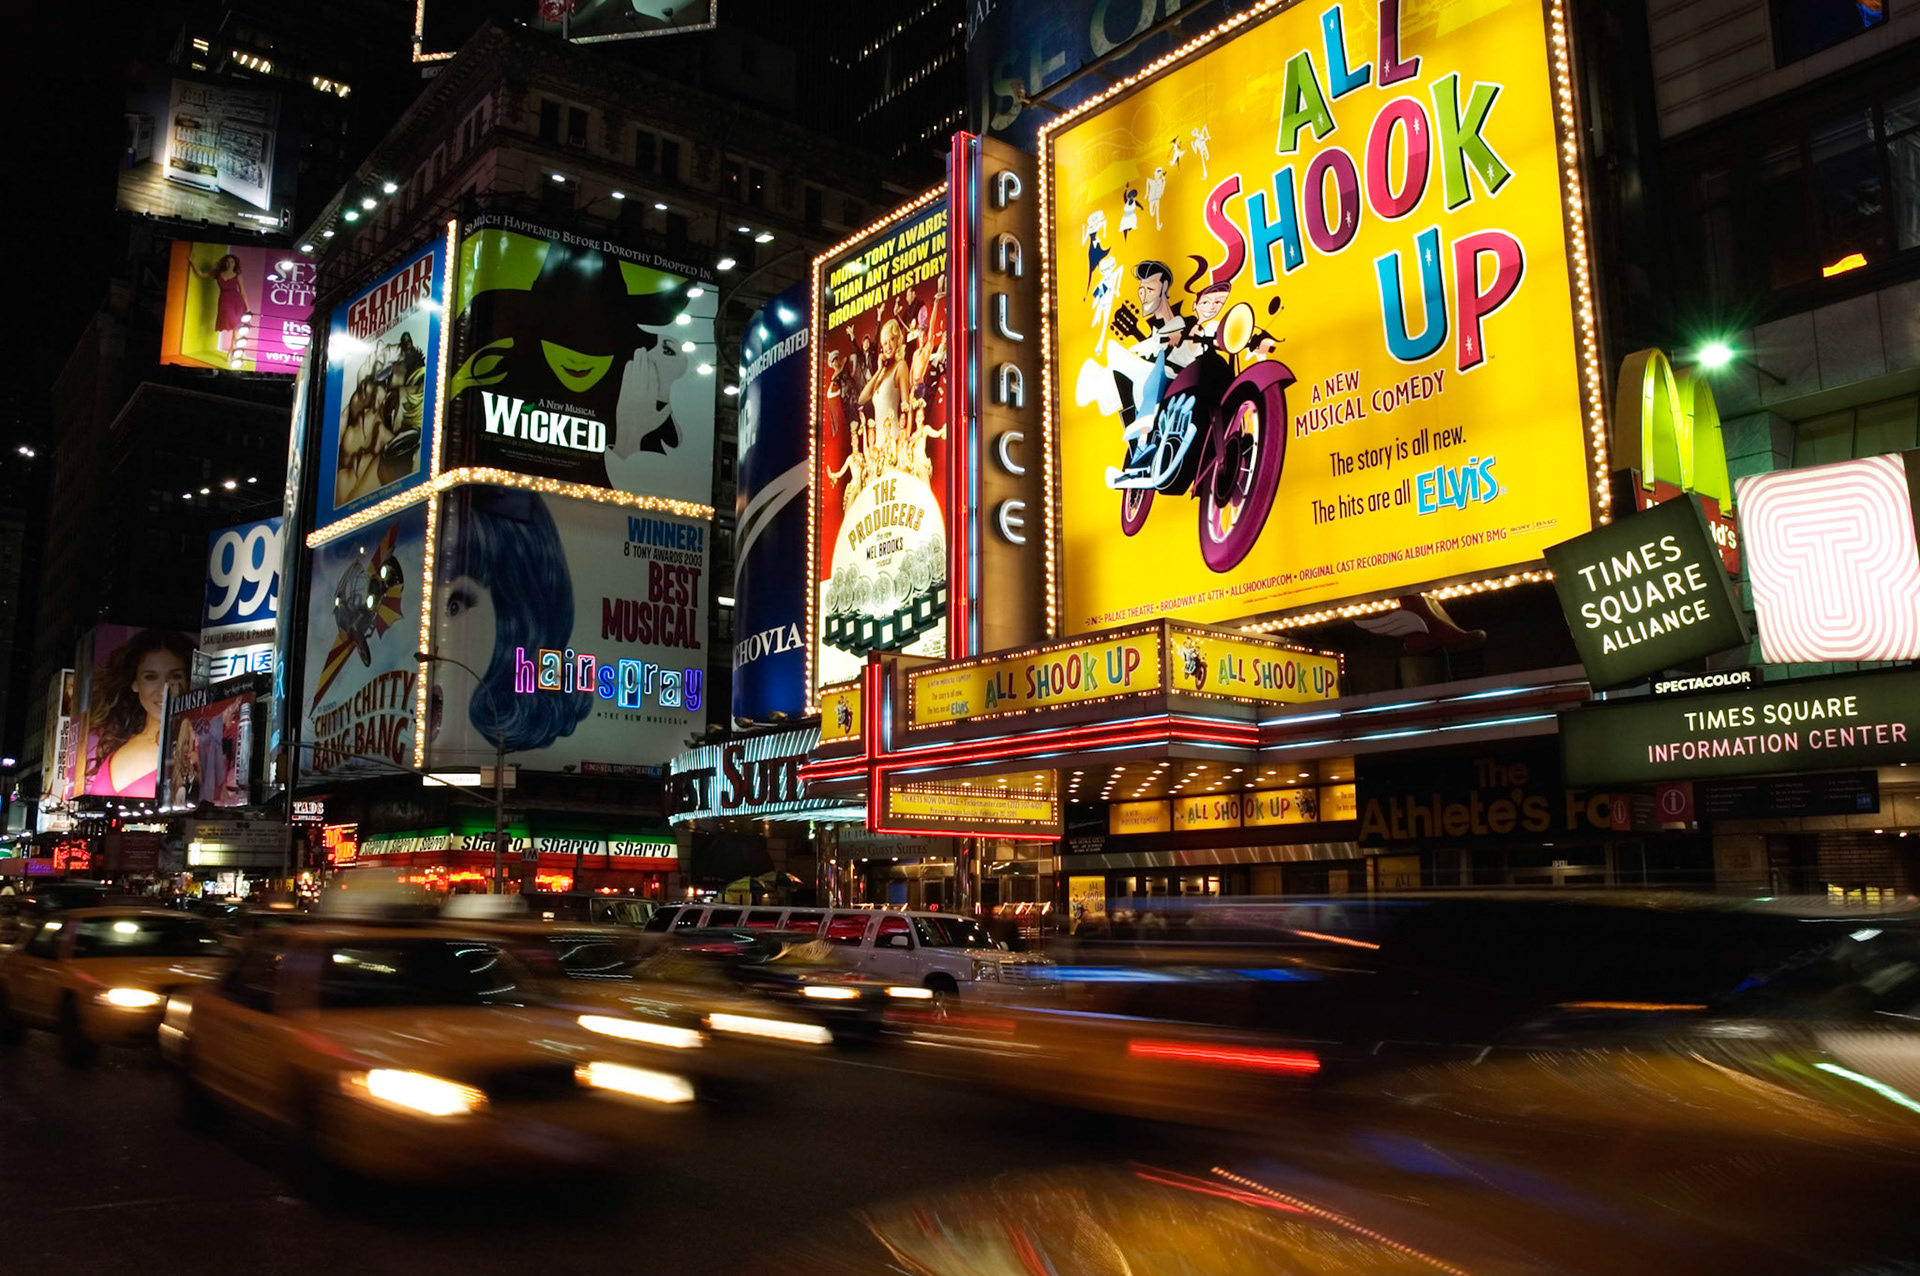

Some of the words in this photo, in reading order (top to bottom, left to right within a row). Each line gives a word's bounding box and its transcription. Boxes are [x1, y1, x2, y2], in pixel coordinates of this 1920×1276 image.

[1276, 0, 1422, 155] ALL
[1204, 71, 1516, 288] SHOOK
[474, 215, 501, 229] MUCH
[504, 215, 560, 240] HAPPENED
[562, 231, 600, 250] BEFORE
[603, 241, 651, 263] DOROTHY
[654, 254, 697, 276] DROPPED
[830, 256, 863, 289] MORE
[864, 237, 896, 268] TONY
[897, 209, 947, 251] AWARDS
[833, 276, 863, 306] THAN
[865, 261, 890, 290] ANY
[891, 244, 929, 275] SHOW
[932, 231, 946, 254] IN
[348, 253, 433, 324] GOOD
[348, 275, 432, 340] VIBRATIONS
[828, 282, 890, 331] BROADWAY
[892, 253, 947, 296] HISTORY
[1373, 224, 1527, 373] UP
[282, 321, 312, 336] tbs
[266, 352, 290, 364] very
[992, 168, 1026, 546] PALACE
[538, 398, 545, 407] A
[546, 400, 564, 412] NEW
[565, 403, 596, 417] MUSICAL
[1294, 396, 1367, 439] MUSICAL
[1371, 369, 1446, 414] COMEDY
[1311, 384, 1322, 404] A
[1324, 369, 1361, 399] NEW
[1330, 452, 1354, 478] The
[1357, 442, 1393, 470] story
[1395, 437, 1409, 462] is
[1412, 428, 1429, 456] all
[1433, 425, 1467, 451] new.
[873, 478, 898, 505] THE
[1311, 500, 1335, 525] The
[1338, 495, 1364, 519] hits
[1367, 491, 1391, 513] are
[1394, 478, 1411, 506] all
[628, 515, 703, 553] WINNER!
[848, 503, 925, 552] PRODUCERS
[866, 545, 879, 561] MEL
[879, 536, 904, 557] BROOKS
[623, 541, 630, 556] 8
[633, 545, 652, 559] TONY
[684, 553, 703, 567] 2003
[1104, 610, 1126, 624] PALACE
[1127, 603, 1155, 620] THEATRE
[1160, 596, 1196, 612] BROADWAY
[1198, 593, 1206, 604] AT
[1207, 588, 1225, 602] 47TH
[1299, 562, 1335, 581] ORIGINAL
[1336, 559, 1355, 574] CAST
[1357, 549, 1403, 569] RECORDING
[1405, 543, 1434, 561] ALBUM
[1435, 538, 1459, 553] FROM
[1461, 532, 1484, 549] SONY
[1486, 527, 1507, 542] BMG
[1578, 536, 1682, 591] TIMES
[648, 561, 702, 608] BEST
[1581, 563, 1707, 628] SQUARE
[222, 631, 245, 643] MEDICAL
[601, 597, 701, 649] MUSICAL
[1603, 599, 1710, 654] ALLIANCE
[514, 647, 703, 712] hairspray
[984, 669, 1017, 709] ALL
[1026, 651, 1098, 700] SHOOK
[1106, 645, 1141, 687] UP
[1218, 653, 1246, 686] ALL
[1252, 658, 1308, 694] SHOOK
[1313, 665, 1336, 698] UP
[1655, 671, 1751, 694] SPECTACOLOR
[315, 696, 353, 738] CHITTY
[354, 670, 418, 718] CHITTY
[604, 712, 618, 720] THE
[647, 715, 683, 725] MUSICAL
[1684, 706, 1756, 732] TIMES
[1762, 696, 1858, 725] SQUARE
[312, 728, 351, 772] BANG
[354, 714, 410, 765] BANG
[1648, 732, 1799, 763] INFORMATION
[1808, 723, 1907, 750] CENTER
[1474, 758, 1529, 789] The
[924, 795, 937, 804] NOW
[1188, 803, 1208, 823] ALL
[1269, 796, 1290, 820] UP
[1359, 788, 1551, 842] Athlete's
[540, 836, 599, 854] sbarro
[614, 840, 671, 857] sbarro
[868, 843, 893, 856] GUEST
[896, 842, 928, 855] SUITES
